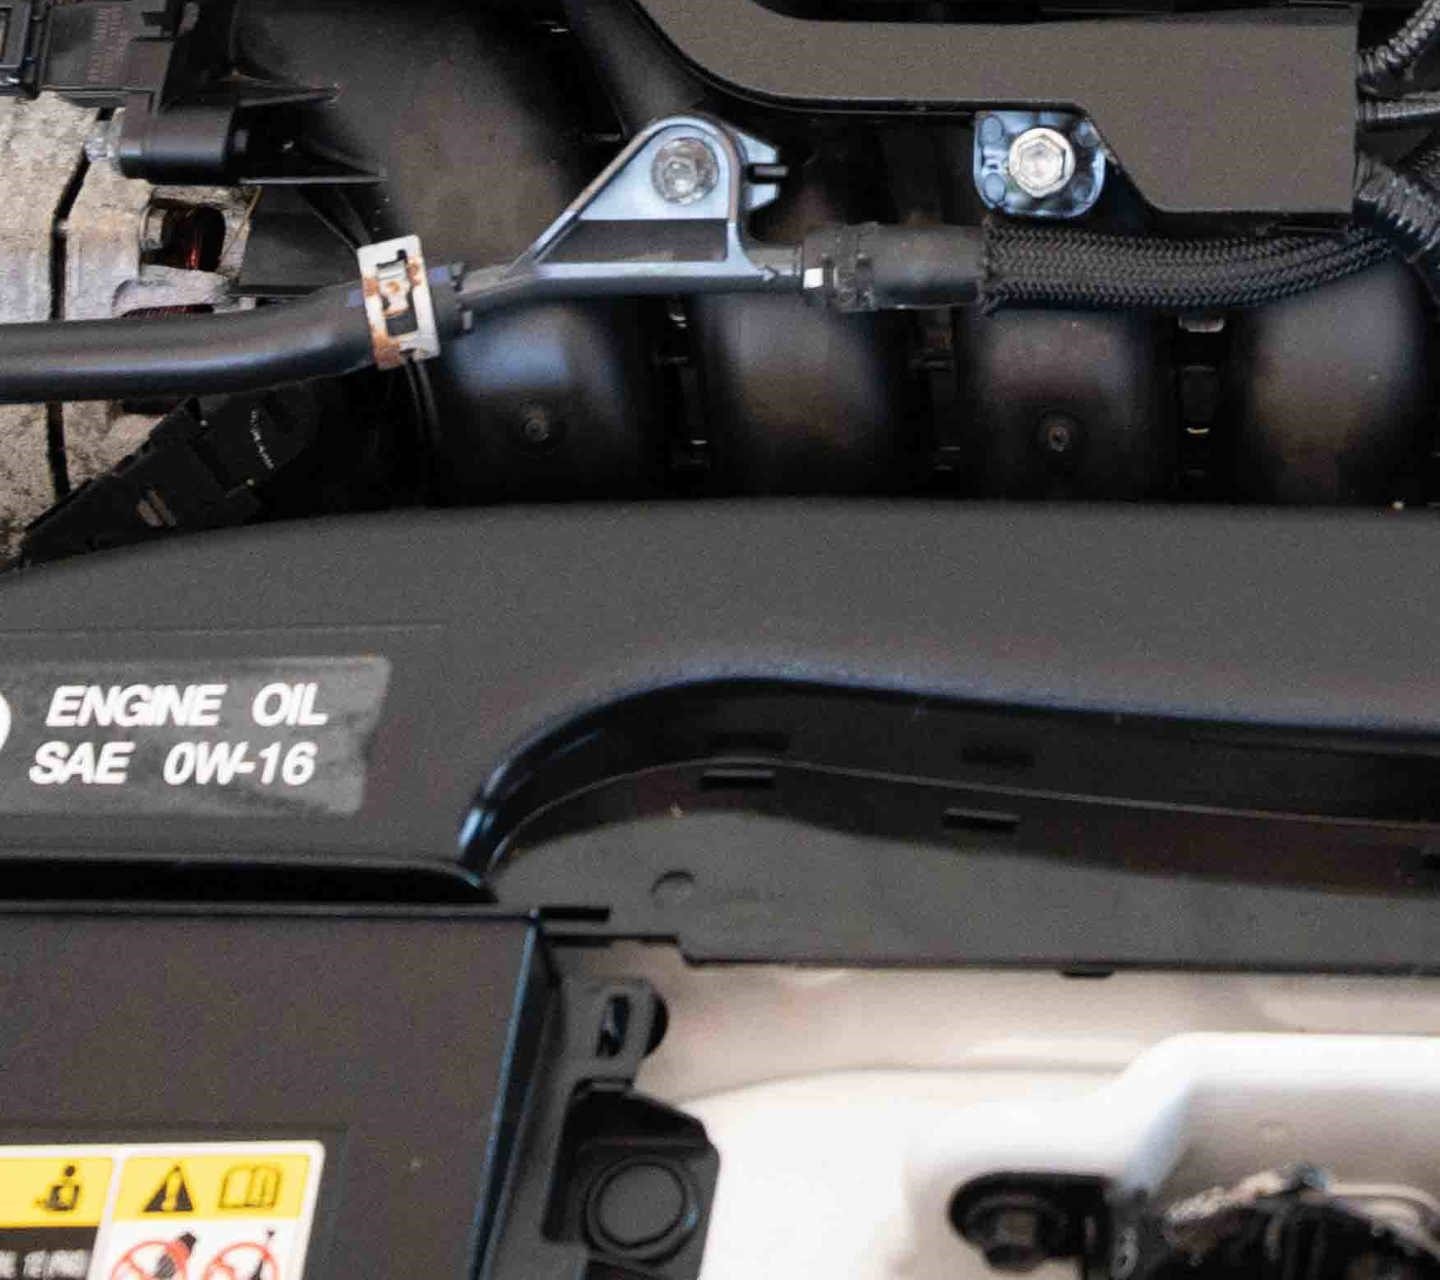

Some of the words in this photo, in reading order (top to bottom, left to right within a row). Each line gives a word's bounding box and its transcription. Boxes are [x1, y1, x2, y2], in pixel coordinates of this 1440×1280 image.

[45, 684, 228, 727] ENGINE
[251, 682, 330, 727] OIL
[28, 741, 136, 784] SAE
[162, 741, 318, 786] 0W-16
